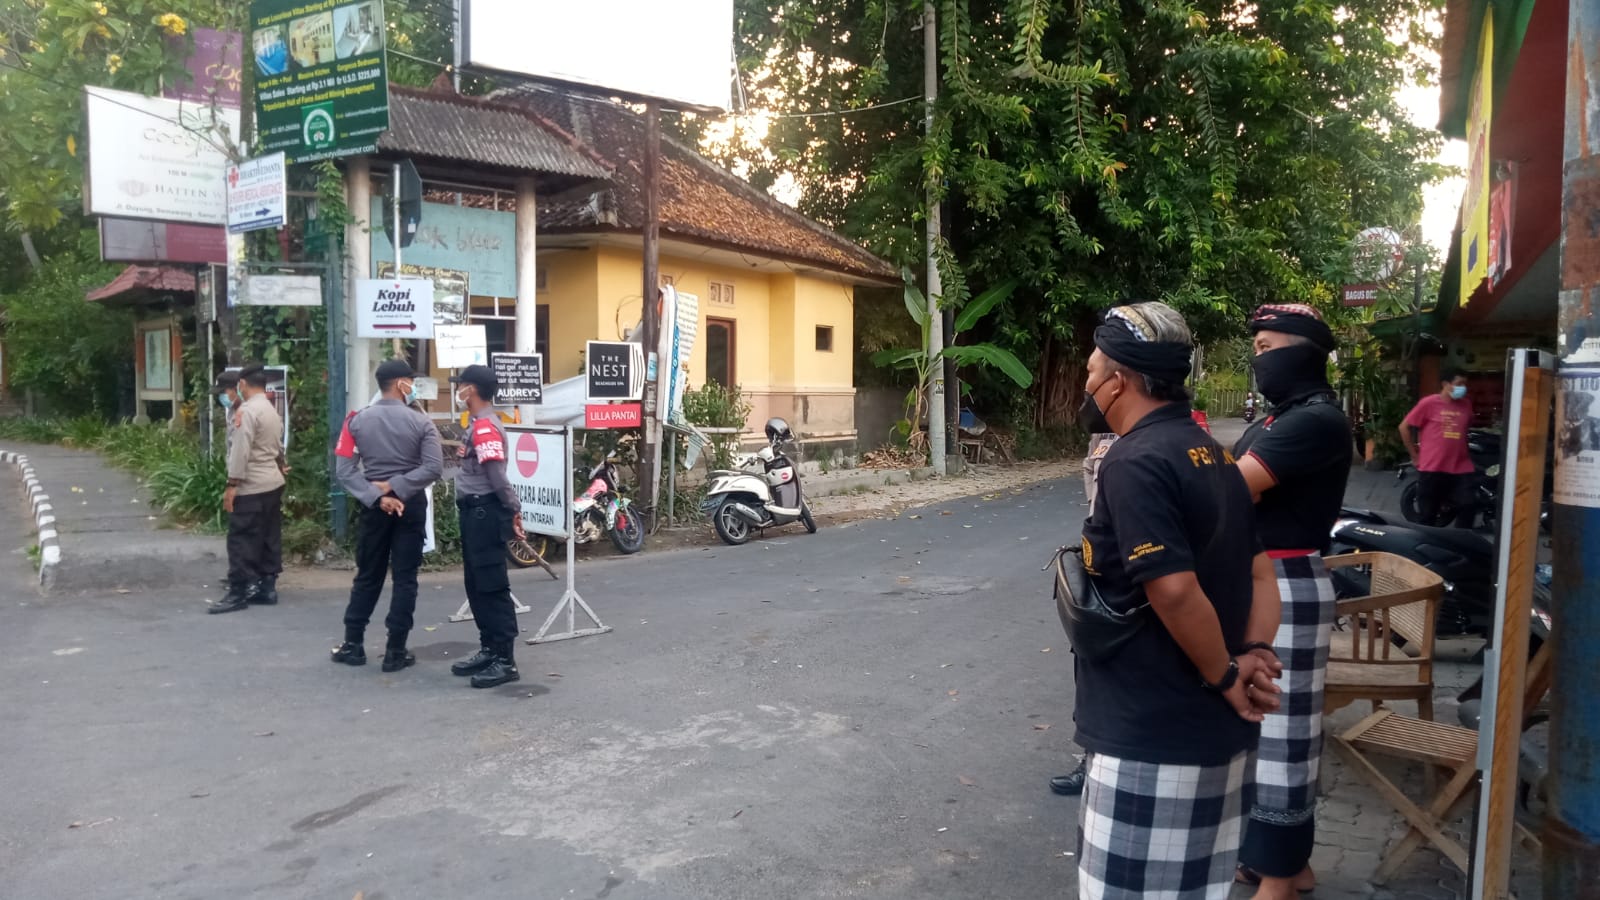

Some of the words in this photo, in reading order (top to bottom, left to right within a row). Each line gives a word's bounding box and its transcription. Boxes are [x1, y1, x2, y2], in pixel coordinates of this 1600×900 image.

[377, 288, 411, 302] Kopi
[371, 300, 416, 312] Lebuh
[592, 364, 628, 377] NEST
[496, 388, 541, 398] AUDREY'S
[590, 411, 611, 421] LILLA
[611, 411, 637, 420] PANTAI
[537, 486, 562, 507] AGAMA
[530, 511, 555, 525] INTARAN
